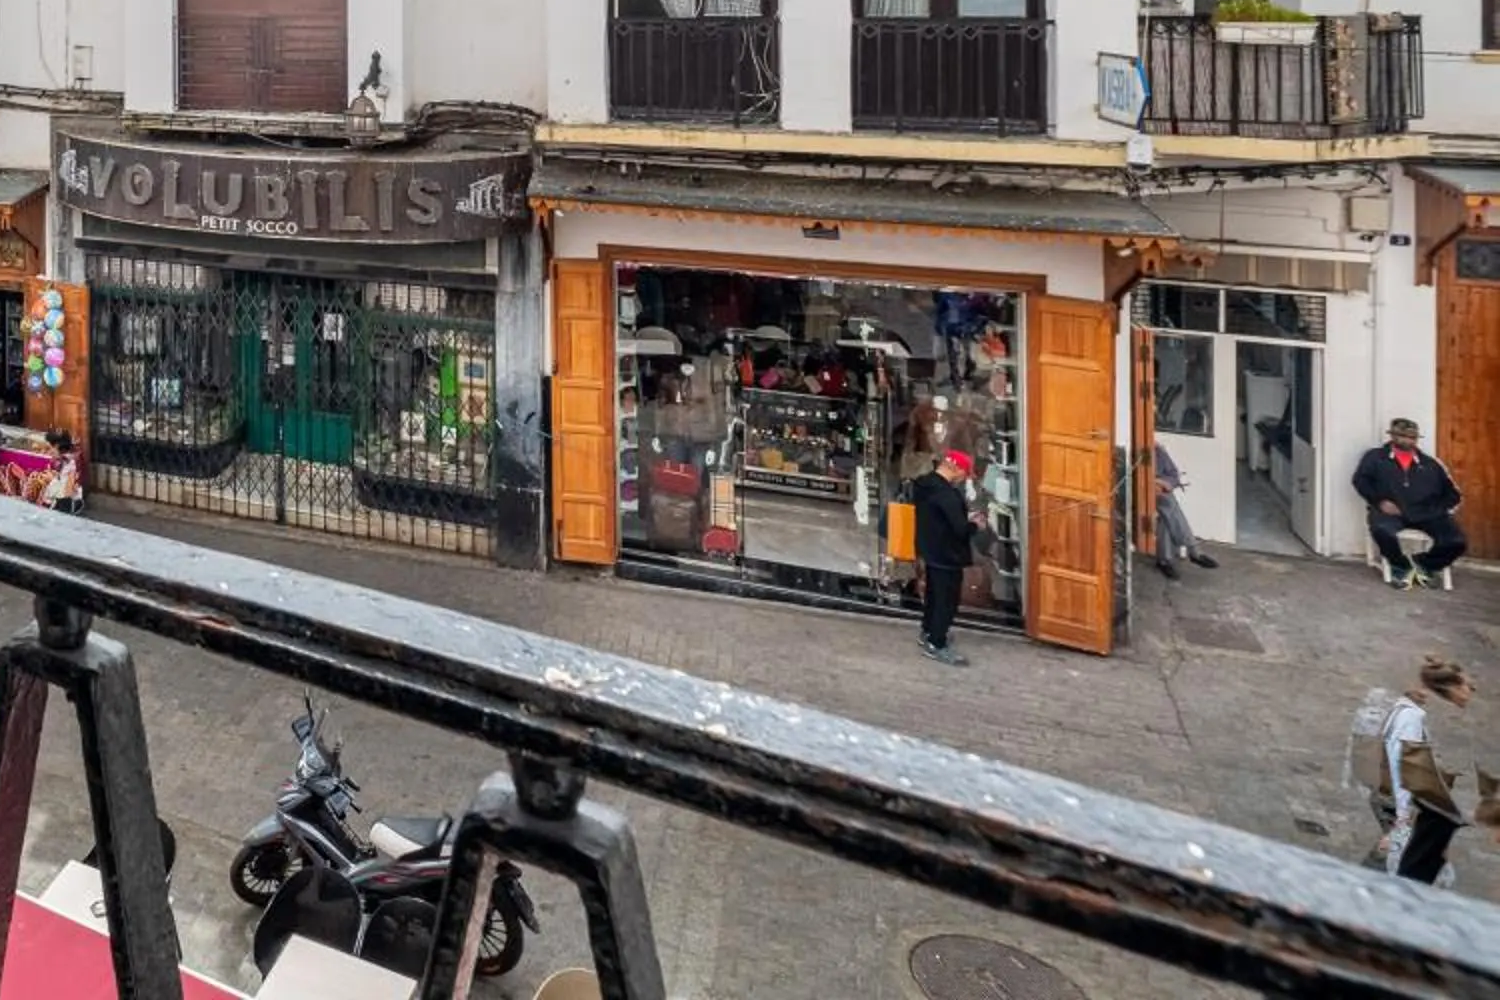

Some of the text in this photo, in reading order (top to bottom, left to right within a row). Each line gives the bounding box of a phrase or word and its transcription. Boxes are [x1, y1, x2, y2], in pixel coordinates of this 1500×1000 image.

[88, 156, 444, 232] VOLUBILIS
[201, 215, 298, 235] PETIT SOCCO
